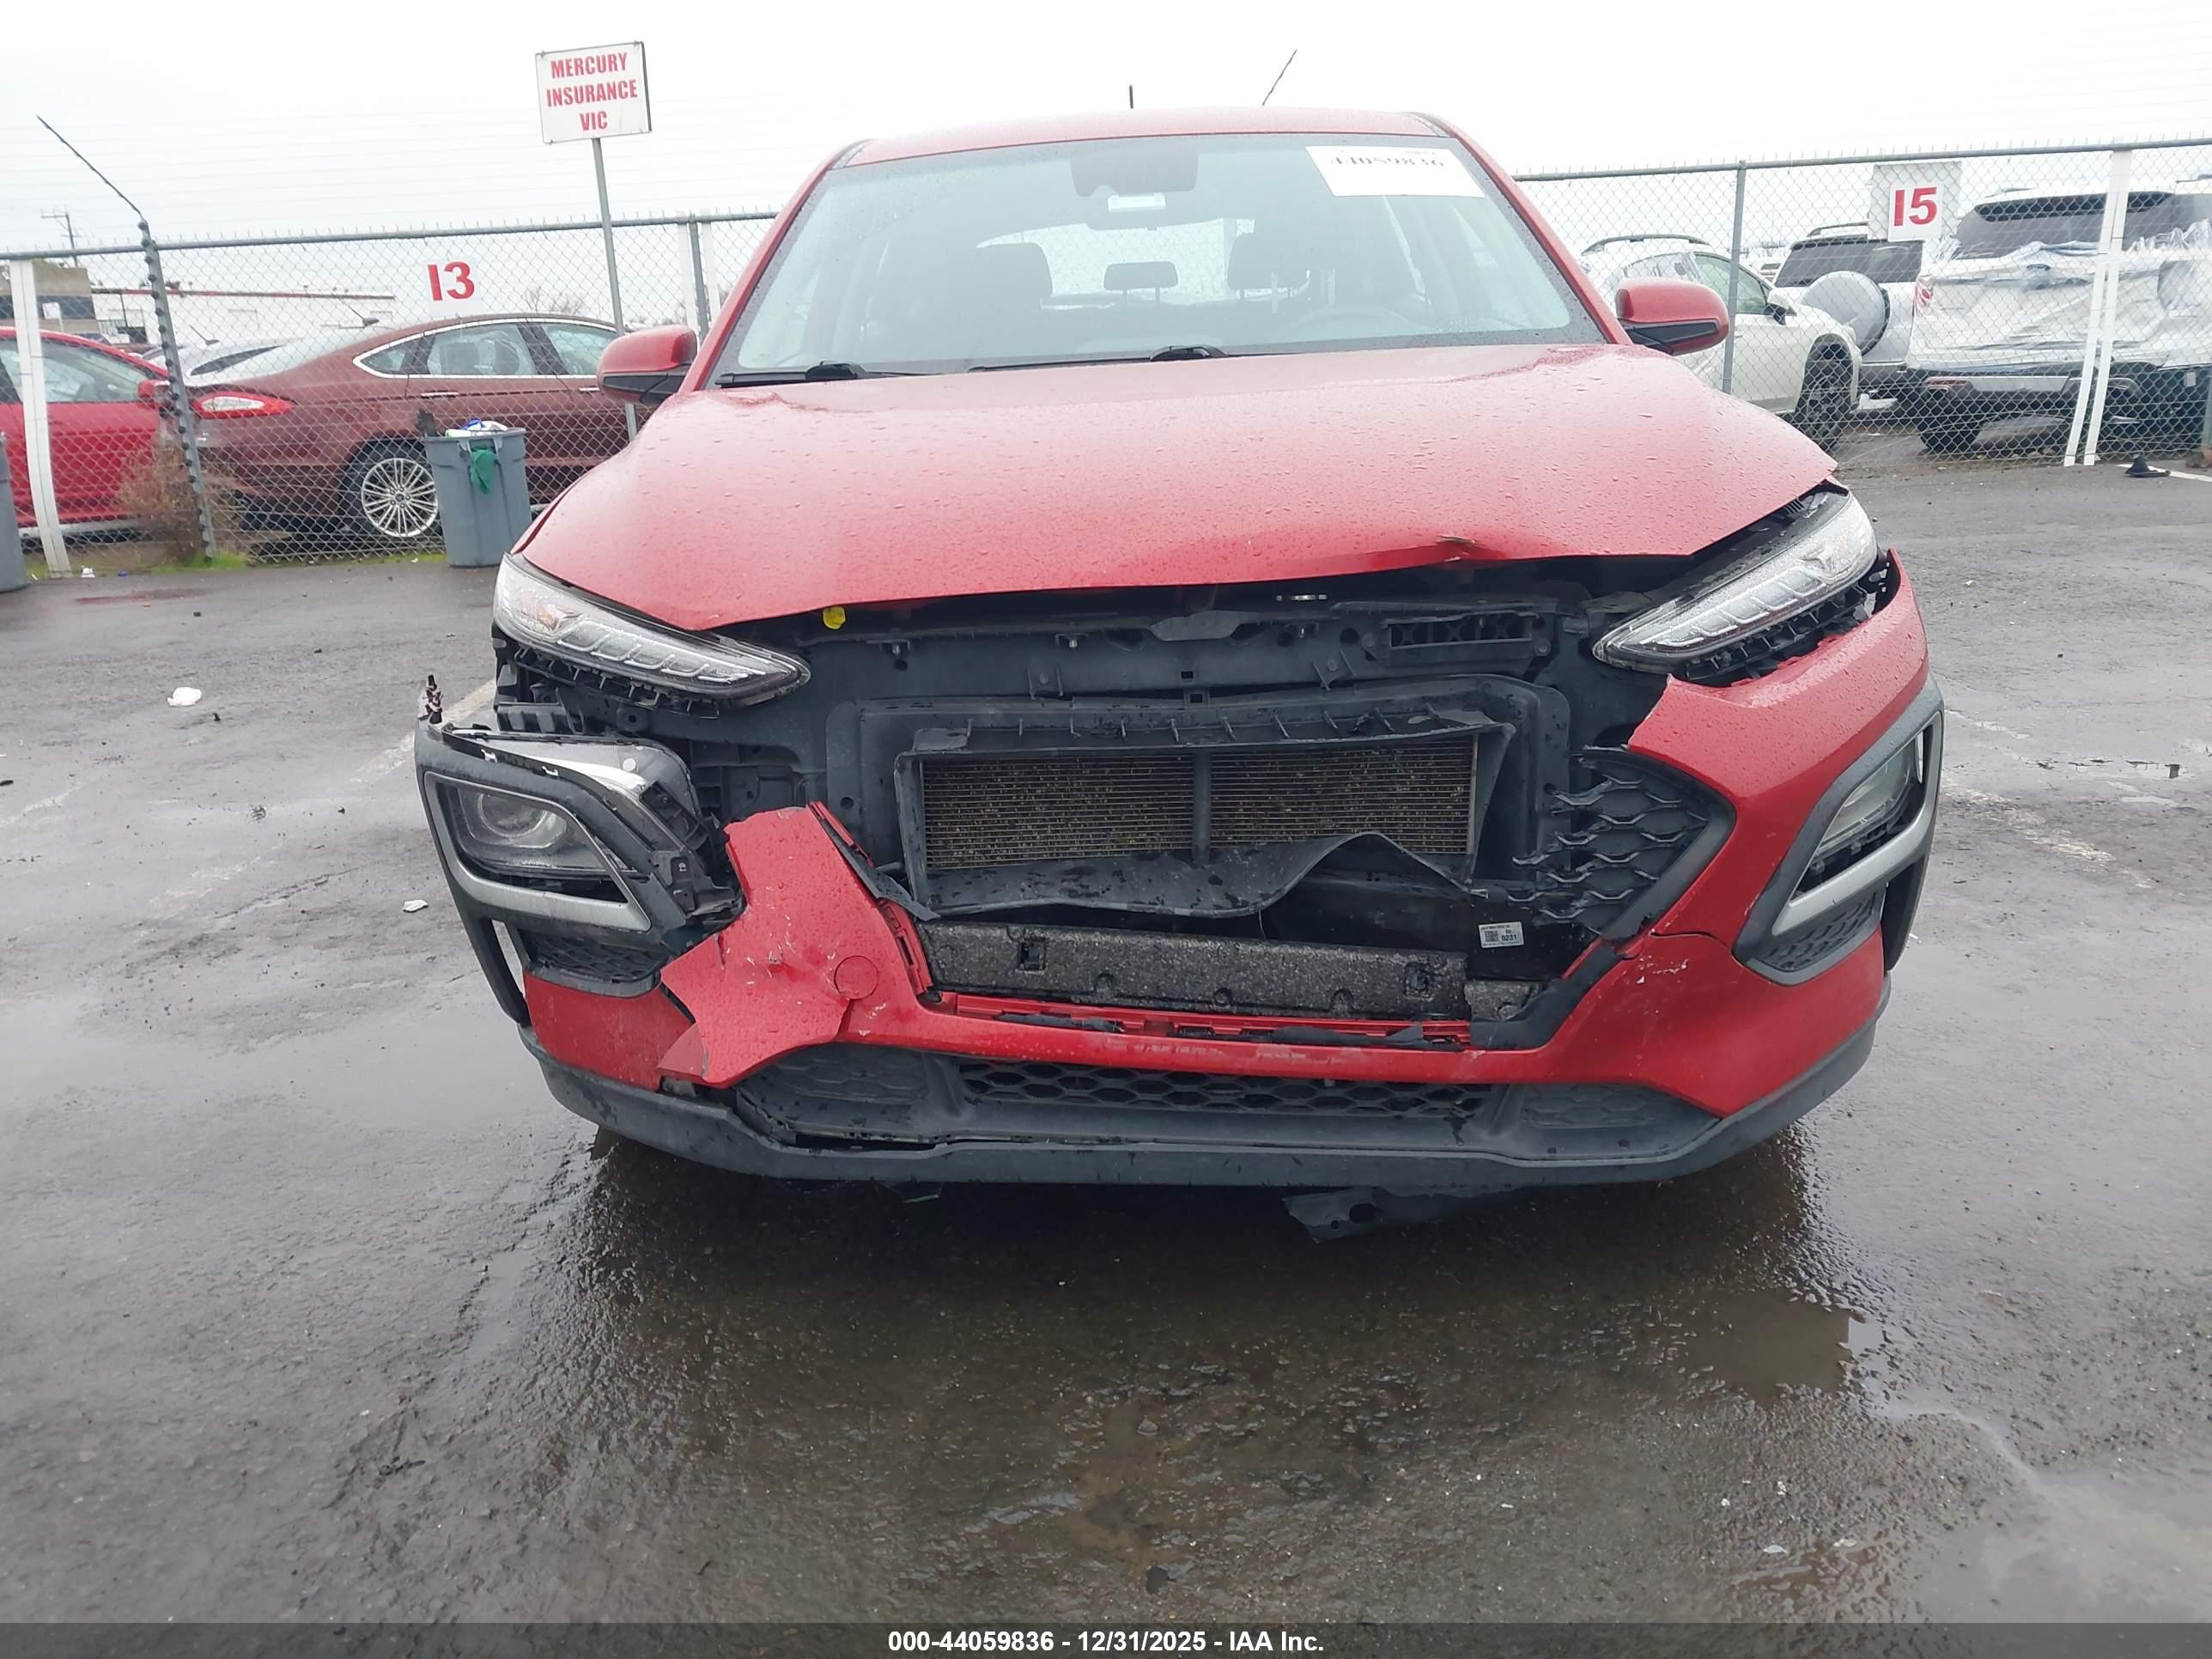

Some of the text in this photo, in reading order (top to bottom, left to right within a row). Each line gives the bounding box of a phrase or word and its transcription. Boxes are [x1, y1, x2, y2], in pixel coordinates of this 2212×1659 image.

[550, 52, 628, 79] MERCURY
[546, 79, 638, 107] INSURANCE
[580, 111, 608, 131] VIC
[1893, 185, 1938, 227] 15
[427, 261, 475, 301] 13
